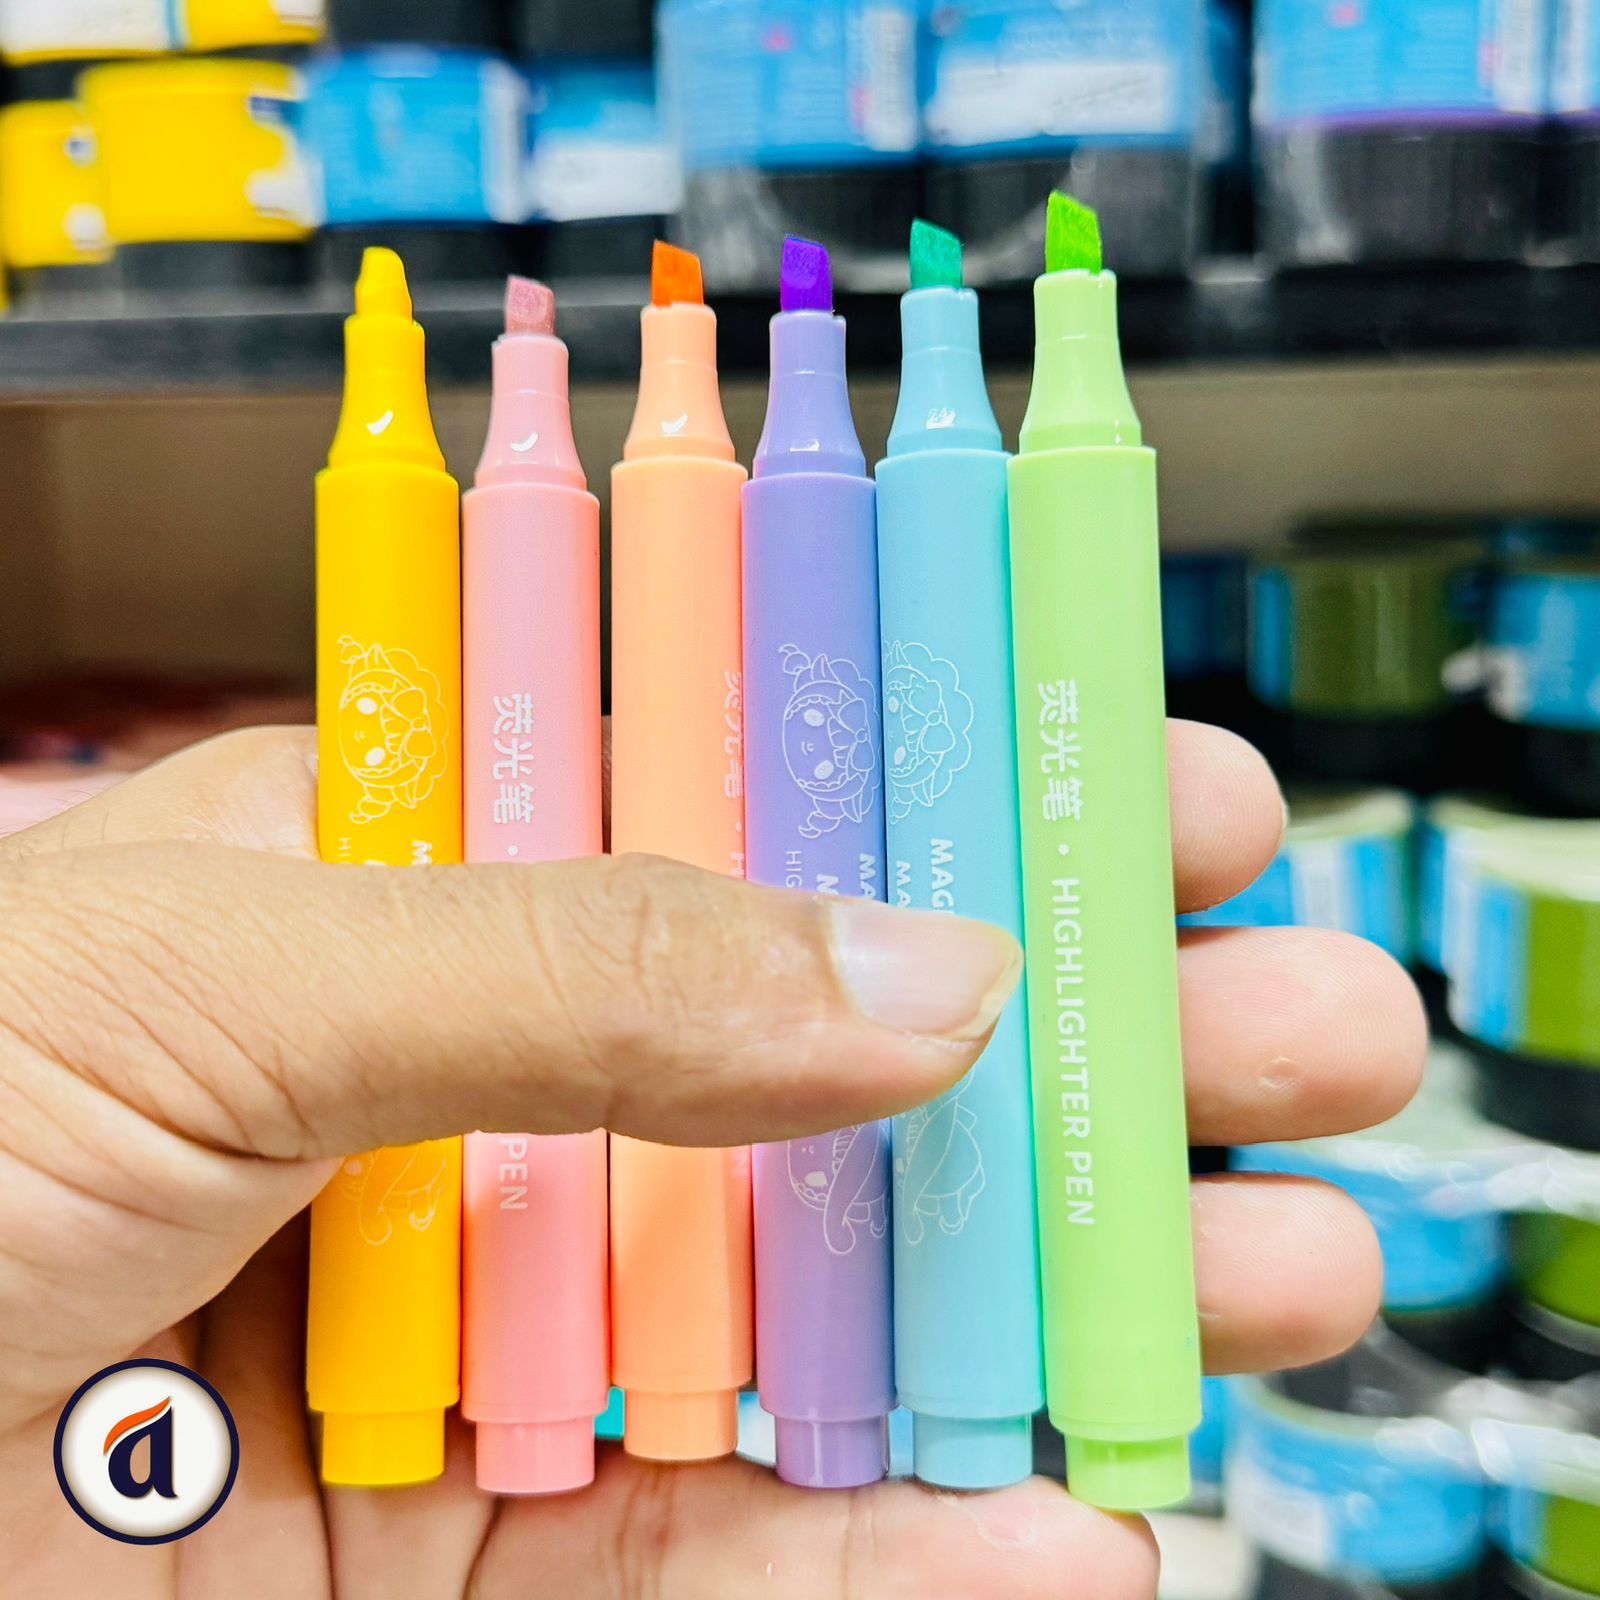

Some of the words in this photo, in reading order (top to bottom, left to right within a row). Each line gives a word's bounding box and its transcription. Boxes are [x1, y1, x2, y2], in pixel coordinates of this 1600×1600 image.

[493, 693, 534, 824] 荧光笔
[1038, 680, 1083, 821] 荧光笔
[930, 838, 954, 914] MAG
[1052, 878, 1091, 1138] HIGHLIGHTER
[499, 1137, 528, 1209] PEN
[1064, 1151, 1095, 1225] PEN
